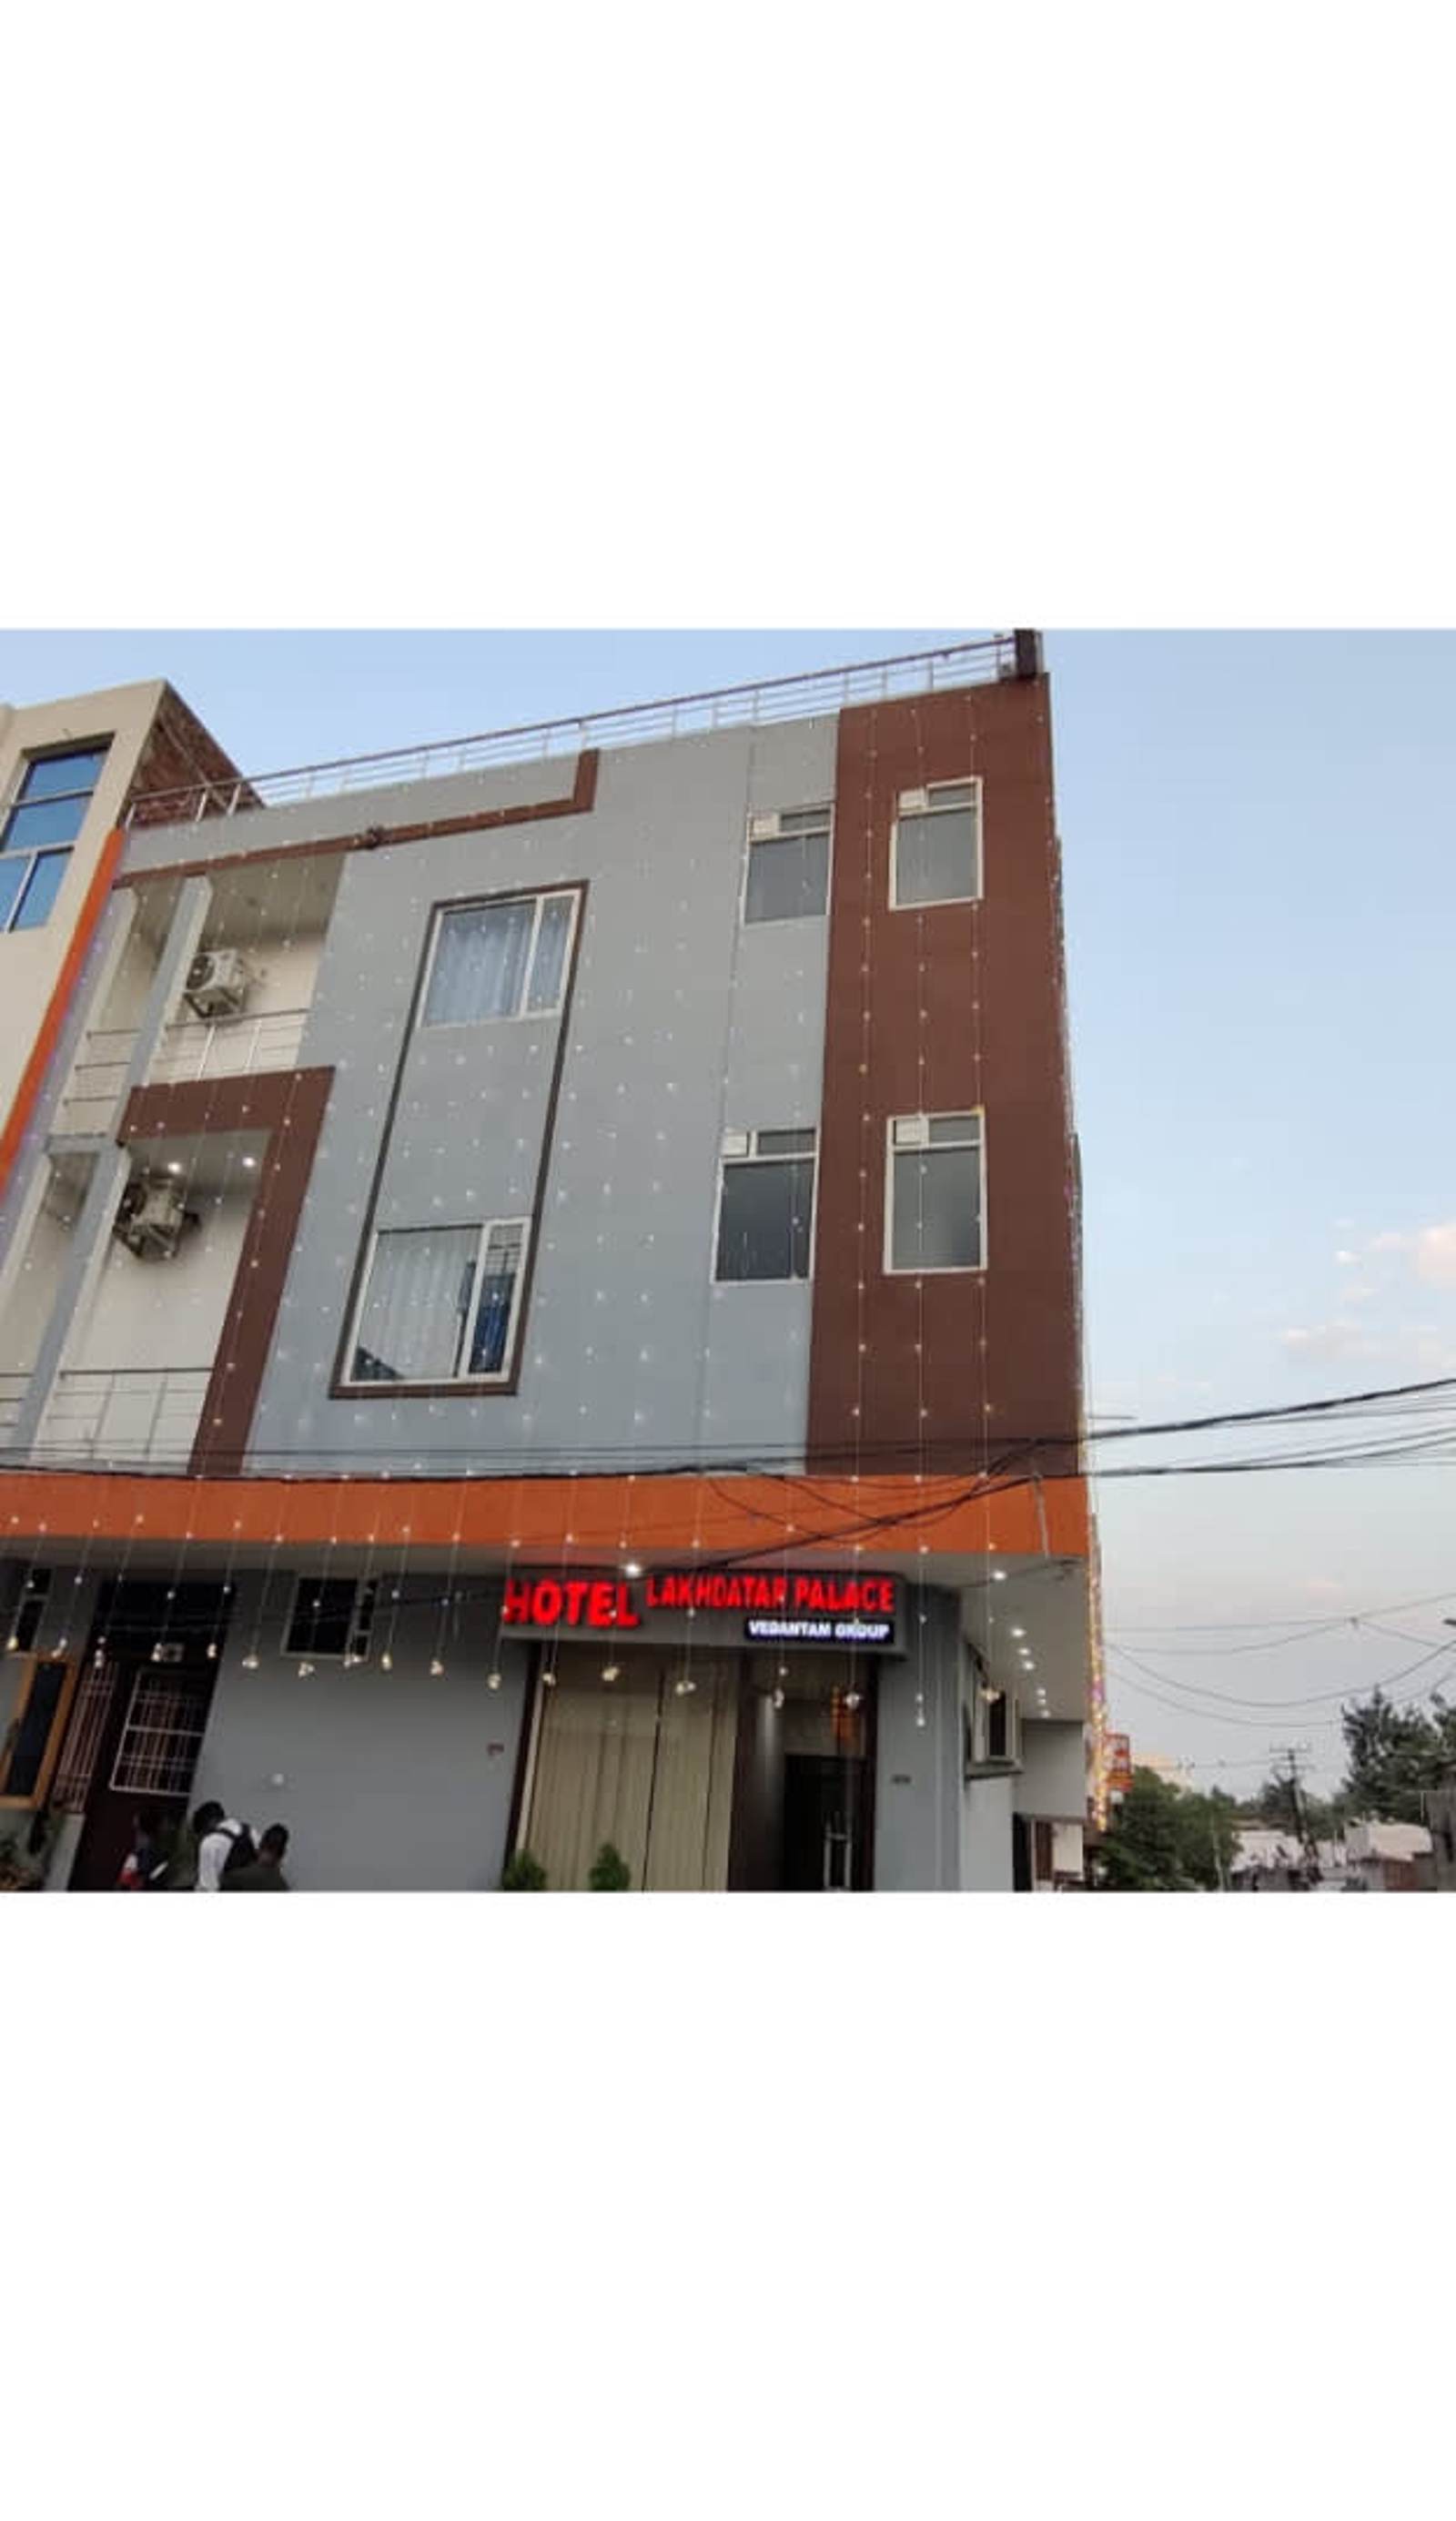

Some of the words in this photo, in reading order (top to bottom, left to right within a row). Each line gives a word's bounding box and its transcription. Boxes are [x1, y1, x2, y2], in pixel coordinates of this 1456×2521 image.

[503, 1579, 639, 1626] HOTEL
[645, 1574, 788, 1610] LAKHDATAR
[794, 1577, 895, 1612] PALACE
[748, 1620, 830, 1637] VEDANTAM
[834, 1623, 890, 1638] GROUP
